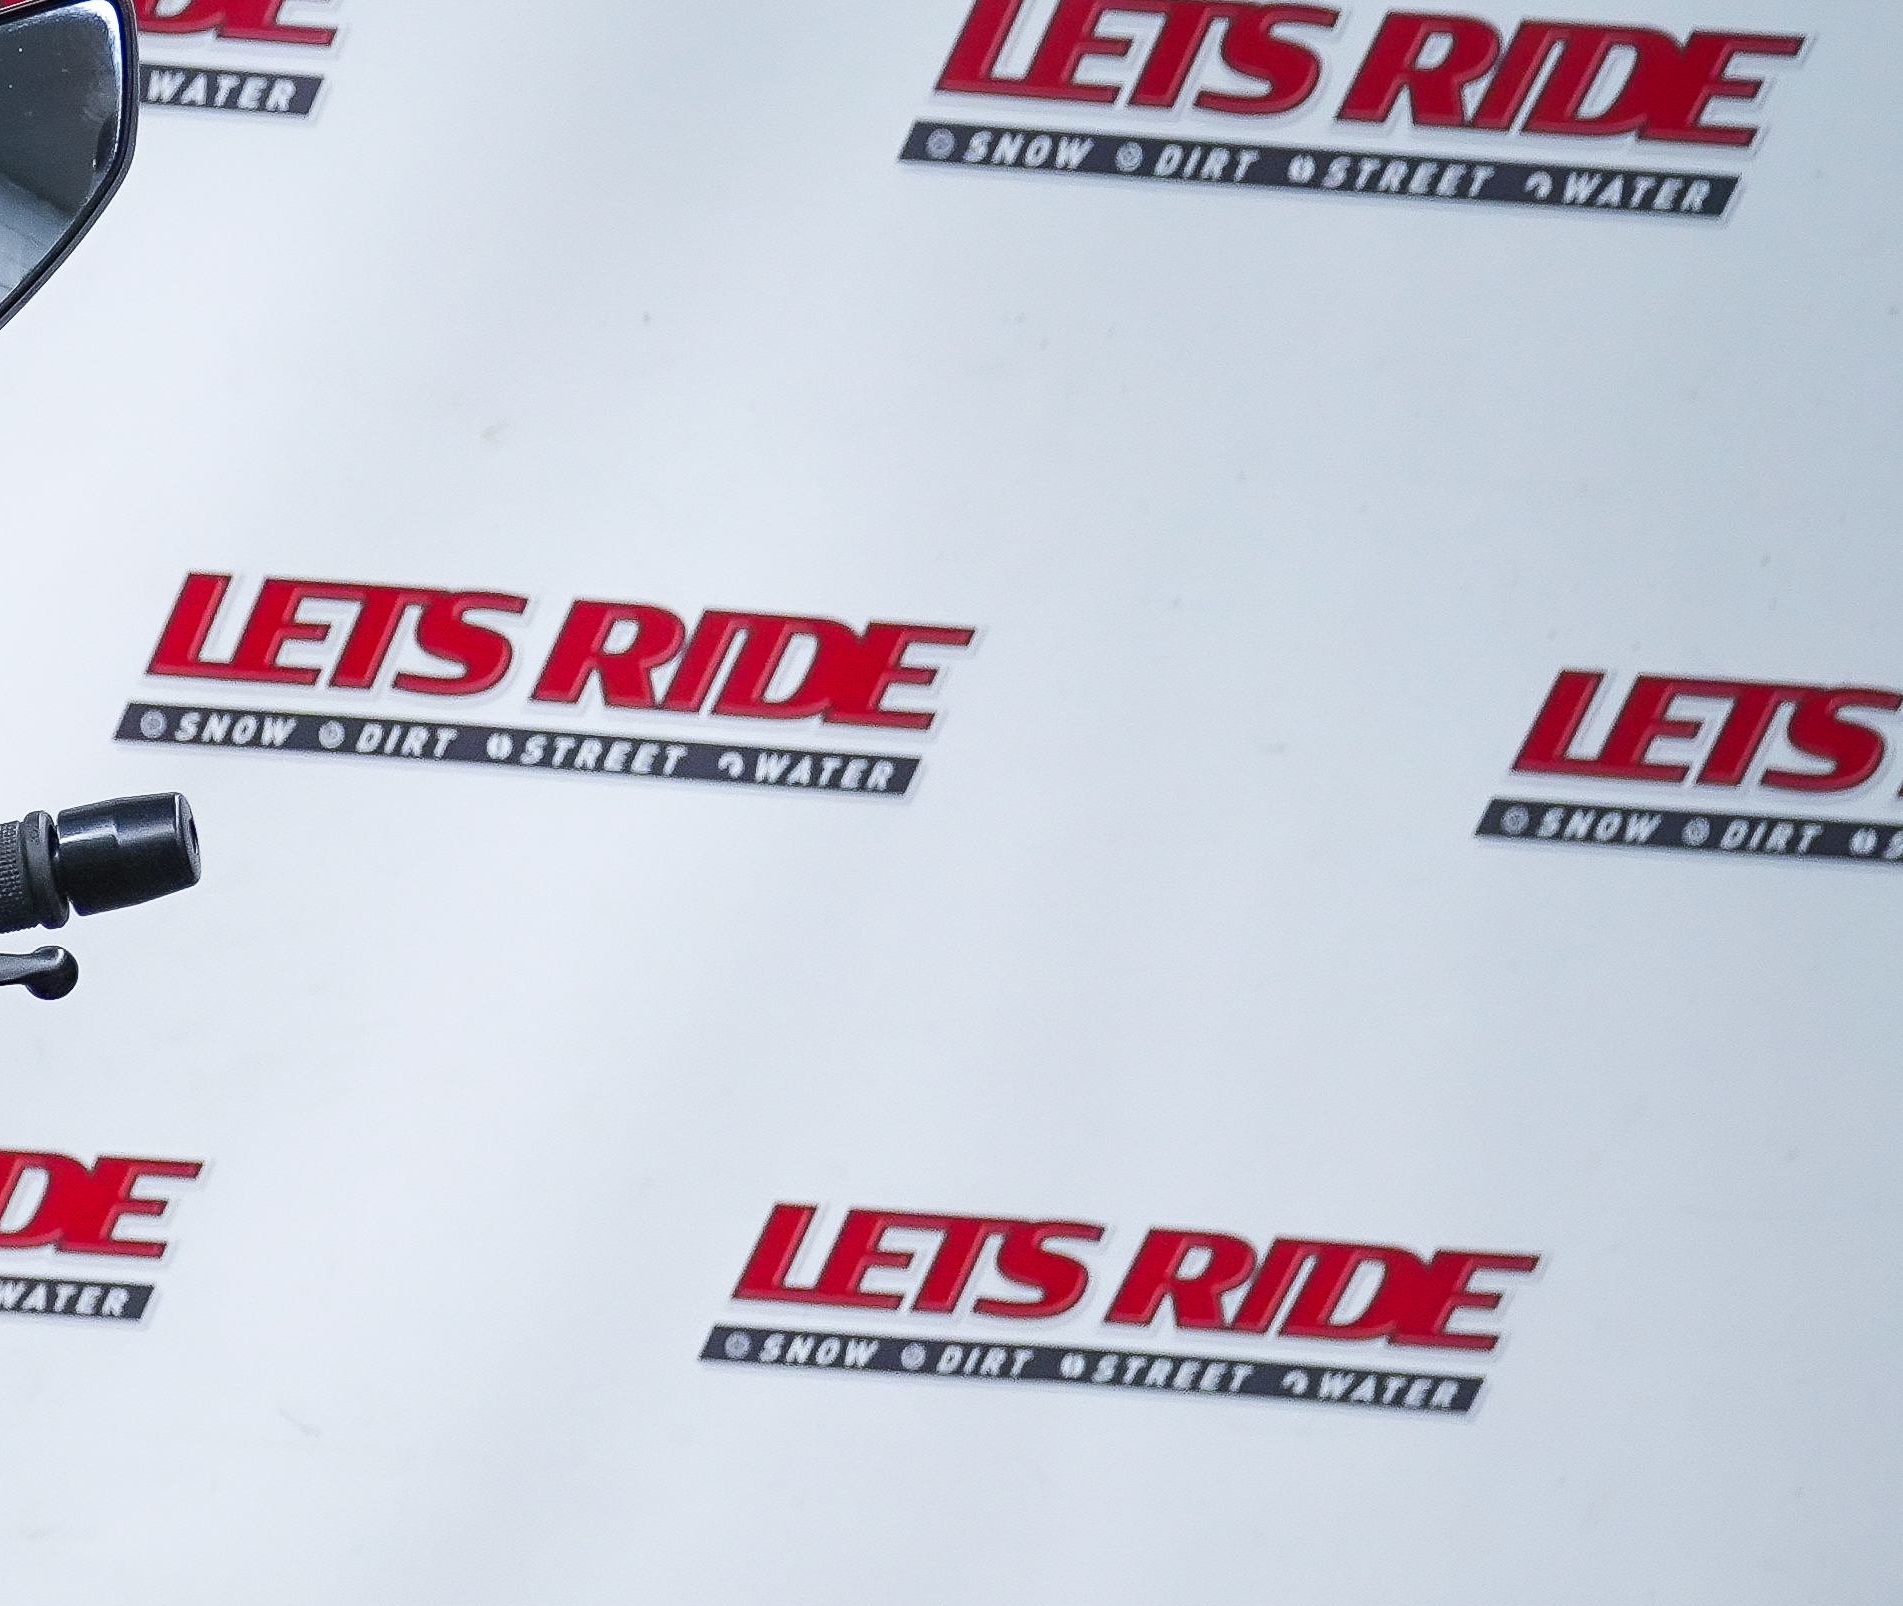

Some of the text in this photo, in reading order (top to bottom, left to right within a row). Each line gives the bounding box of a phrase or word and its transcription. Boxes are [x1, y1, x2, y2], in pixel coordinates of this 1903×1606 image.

[146, 69, 298, 110] WATER
[937, 0, 1800, 147] LETS RIDE
[962, 130, 1711, 212] SNOW DIRT STREET WATER
[147, 571, 971, 730] LETS RIDE
[173, 710, 895, 790] SNOW DIRT STREET WATER
[1512, 669, 1903, 793] LETS
[1536, 807, 1822, 853] SNOW DIRT
[733, 1202, 1538, 1352] LETS RIDE
[758, 1332, 1459, 1407] SNOW DIRT STREET WATER
